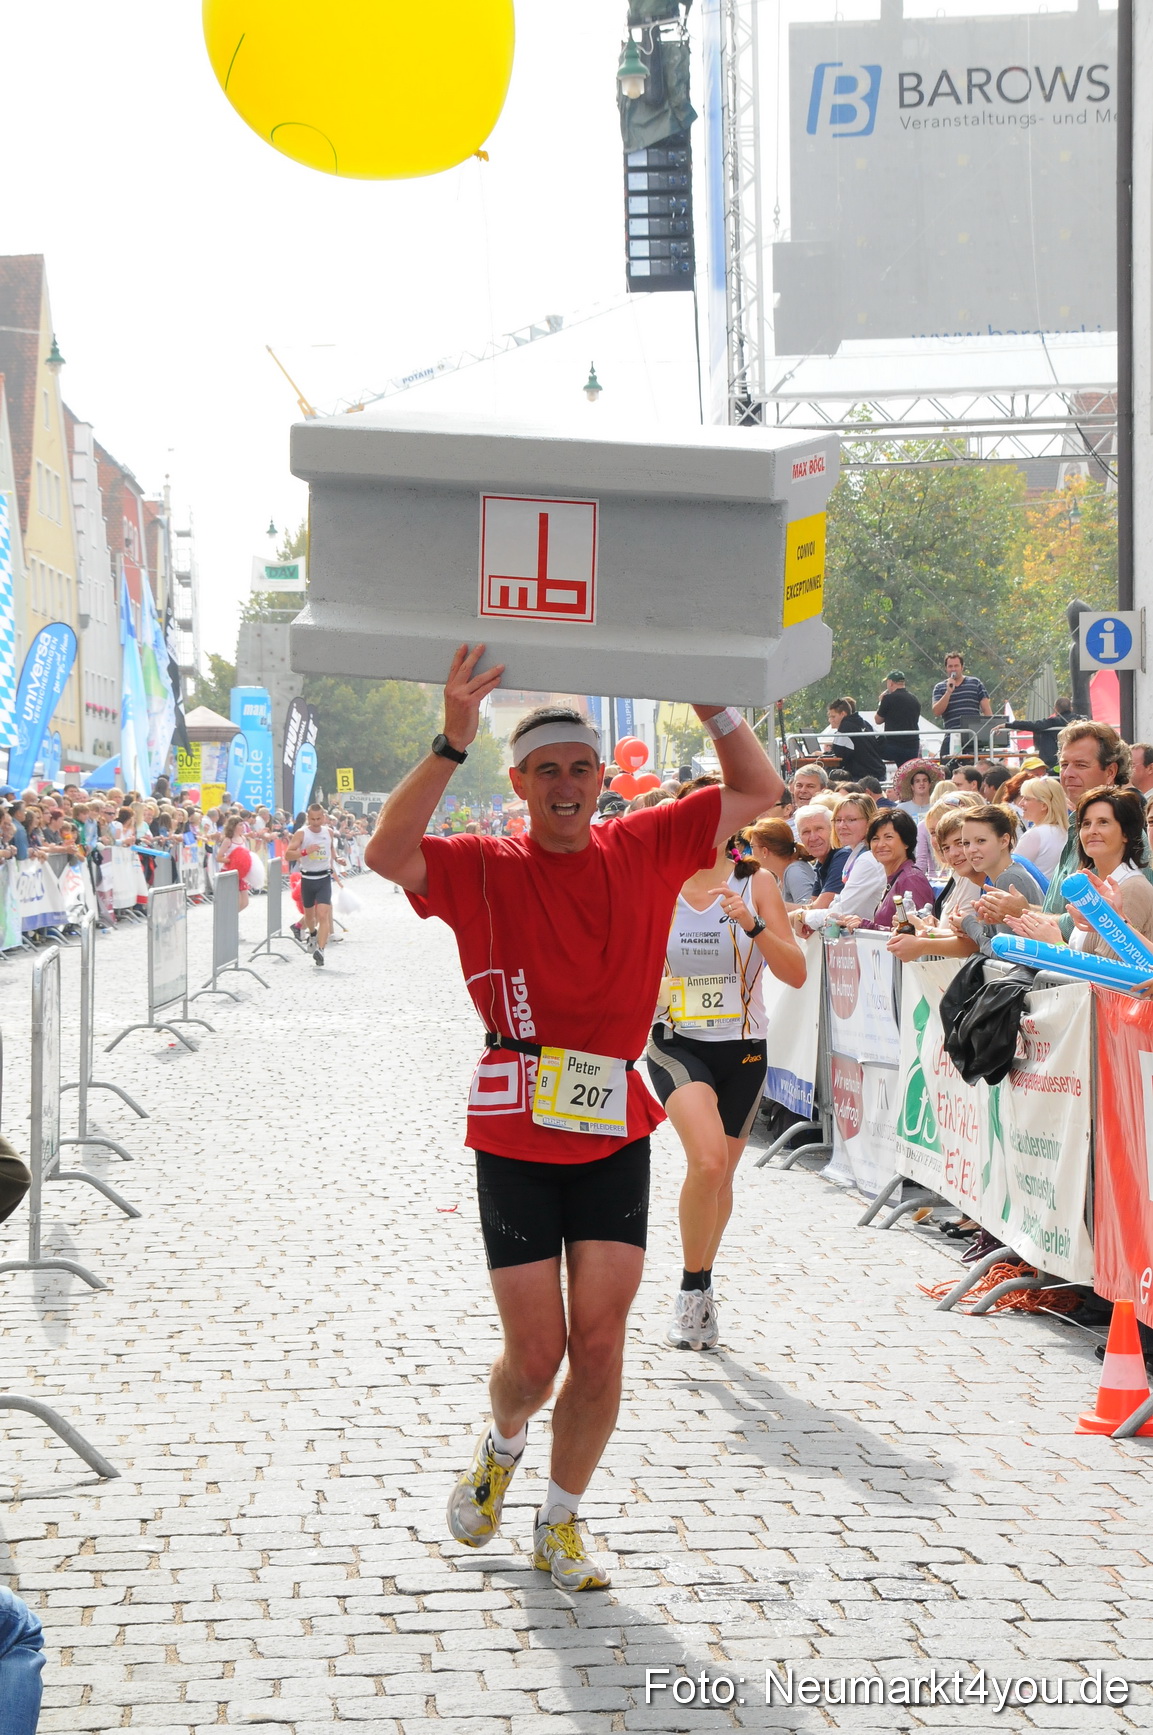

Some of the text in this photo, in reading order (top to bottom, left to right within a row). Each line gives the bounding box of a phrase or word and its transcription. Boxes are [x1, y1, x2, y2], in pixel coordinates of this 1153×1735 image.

[898, 64, 1111, 109] BAROWS
[900, 110, 1044, 130] Veranstaltungs-
[1053, 109, 1087, 125] und
[402, 367, 434, 385] POTAIN
[792, 455, 826, 479] MAX BÖGL
[797, 541, 816, 561] CONVOI
[269, 566, 297, 577] DAV
[786, 574, 822, 600] EXCEPTIONNEL
[284, 708, 301, 768] THULE
[341, 775, 350, 787] B
[687, 974, 737, 988] Annemarie
[511, 968, 536, 1039] BÖGL
[701, 992, 724, 1009] 82
[567, 1056, 601, 1076] Peter
[541, 1076, 548, 1088] B
[570, 1083, 614, 1109] 207
[589, 1123, 625, 1133] PFLEIDERER
